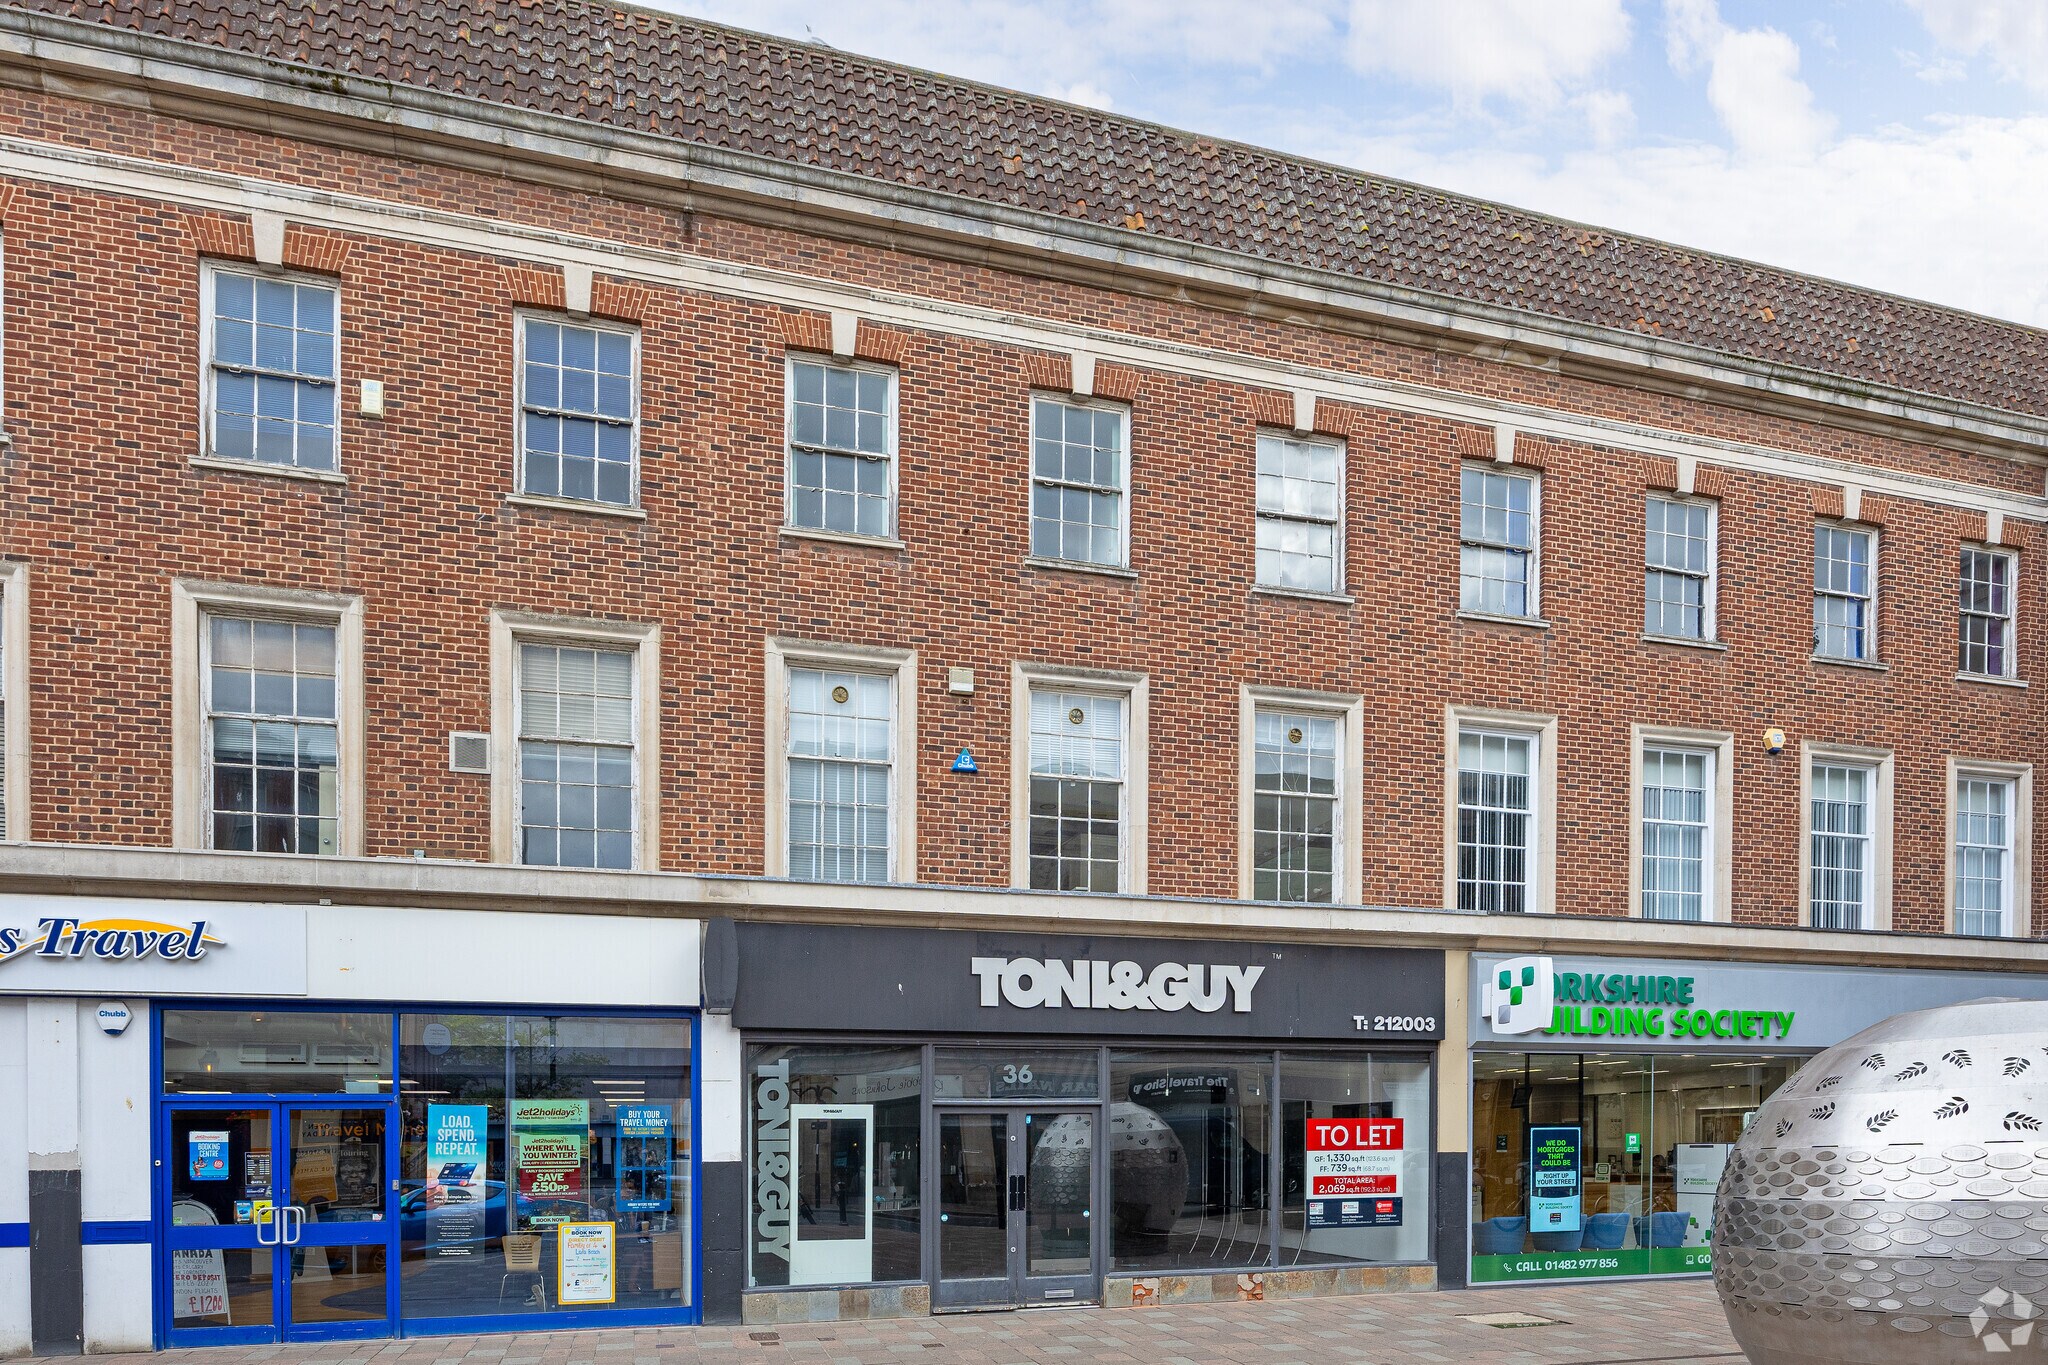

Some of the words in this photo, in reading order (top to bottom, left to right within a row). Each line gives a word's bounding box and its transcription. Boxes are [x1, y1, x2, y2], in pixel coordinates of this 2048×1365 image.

[37, 917, 207, 958] Travel
[971, 956, 1266, 1013] TONI&GUY
[99, 1010, 127, 1018] Chubb
[1352, 1015, 1369, 1031] T:
[1373, 1015, 1436, 1032] 212003
[1670, 1008, 1797, 1038] SOCIETY
[1002, 1064, 1034, 1084] 36
[516, 1107, 575, 1118] jet2holidays
[628, 1110, 642, 1119] BUY
[643, 1110, 661, 1119] YOUR
[442, 1115, 474, 1129] LOAD.
[620, 1118, 644, 1127] TRAVEL
[645, 1118, 669, 1127] MONEY
[315, 1122, 369, 1137] Travel
[437, 1128, 478, 1142] SPEND.
[1315, 1125, 1349, 1147] TO
[1356, 1125, 1397, 1146] LET
[197, 1143, 221, 1151] BOOKING
[435, 1142, 479, 1156] REPEAT.
[1537, 1145, 1575, 1153] MORTGAGES
[199, 1150, 219, 1158] CENTRE
[1314, 1155, 1326, 1163] GF:
[1326, 1153, 1351, 1163] 1,330
[1351, 1156, 1366, 1164] sq.ft
[1547, 1152, 1565, 1160] THAT
[757, 1058, 790, 1263] TONI&GUY
[1330, 1163, 1348, 1173] 739
[1348, 1165, 1362, 1173] sq.ft
[536, 1172, 565, 1182] SAVE
[1543, 1172, 1560, 1180] RIGHT
[531, 1181, 570, 1193] £50PP
[1318, 1184, 1346, 1195] 2,069
[1345, 1185, 1361, 1194] sq.ft
[1515, 1261, 1543, 1272] CALL
[1544, 1259, 1578, 1271] 01482
[1578, 1258, 1598, 1270] 977
[1599, 1257, 1619, 1269] 856
[1697, 1254, 1712, 1264] GO
[574, 1279, 580, 1287] £
[188, 1294, 223, 1314] £1200
